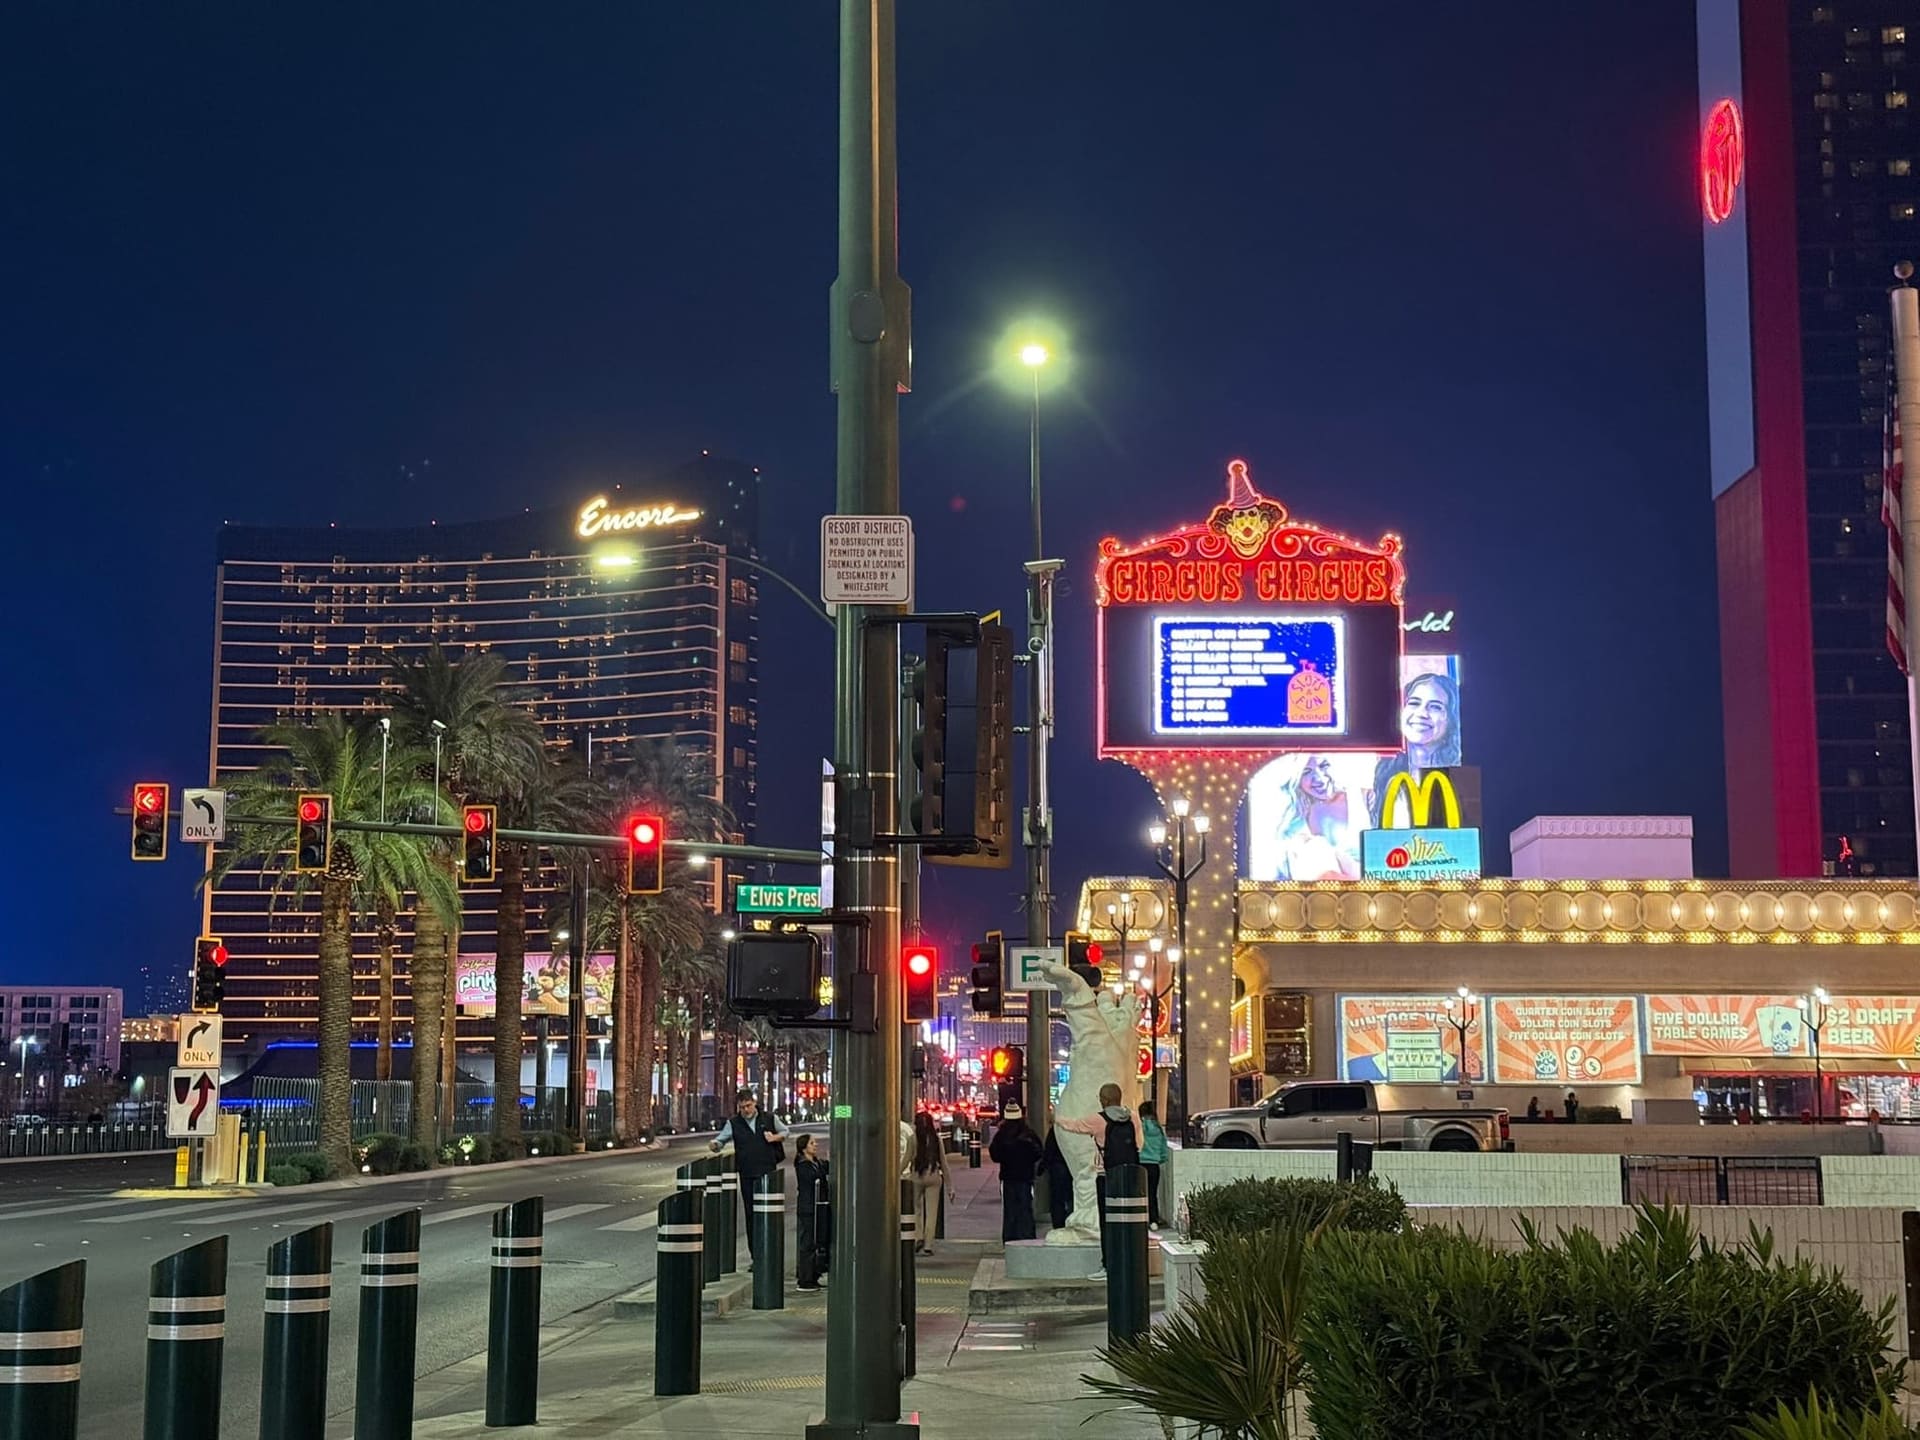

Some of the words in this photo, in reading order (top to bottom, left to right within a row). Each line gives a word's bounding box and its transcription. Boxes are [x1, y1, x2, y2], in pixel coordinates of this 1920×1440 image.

[578, 497, 701, 537] Encore
[828, 521, 860, 534] RESORT
[829, 537, 839, 546] NO
[840, 537, 884, 546] OBSTRUCTIVE
[886, 537, 904, 546] USES
[829, 548, 865, 558] PERMITTED
[867, 548, 877, 558] ON
[879, 548, 904, 558] PUBLIC
[827, 559, 861, 569] SIDEWALKS
[863, 559, 871, 569] AT
[872, 559, 905, 569] LOCATIONS
[836, 571, 878, 580] DESIGNATED
[880, 571, 888, 580] BY
[891, 571, 896, 580] A
[843, 582, 864, 592] WHITE
[864, 582, 889, 592] STRIPE
[1111, 560, 1243, 604] CIRCUS
[1256, 559, 1388, 603] CIRCUS
[185, 826, 218, 837] ONLY
[1365, 870, 1414, 880] WELCOME
[1414, 870, 1427, 880] TO
[1428, 869, 1446, 880] LAS
[1447, 869, 1480, 880] VEGAS
[740, 887, 746, 896] E
[749, 887, 785, 906] Elvis
[787, 887, 821, 907] Presl
[1515, 1007, 1559, 1016] QUARTER
[1561, 1007, 1583, 1016] COIN
[1585, 1007, 1615, 1016] SLOTS
[1827, 1008, 1850, 1026] $2
[1856, 1008, 1915, 1024] DRAFT
[1349, 1012, 1420, 1030] VINTAGE
[1520, 1019, 1556, 1028] DOLLAR
[1558, 1019, 1580, 1028] COIN
[1583, 1019, 1611, 1028] SLOTS
[1654, 1012, 1684, 1025] FIVE
[1688, 1012, 1740, 1025] DOLLAR
[1509, 1031, 1530, 1040] FIVE
[1532, 1031, 1568, 1040] DOLLAR
[1570, 1031, 1592, 1040] COIN
[1594, 1031, 1626, 1040] SLOTS
[1655, 1026, 1698, 1040] TABLE
[1703, 1026, 1748, 1040] GAMES
[1828, 1028, 1876, 1045] BEER
[183, 1051, 214, 1061] ONLY
